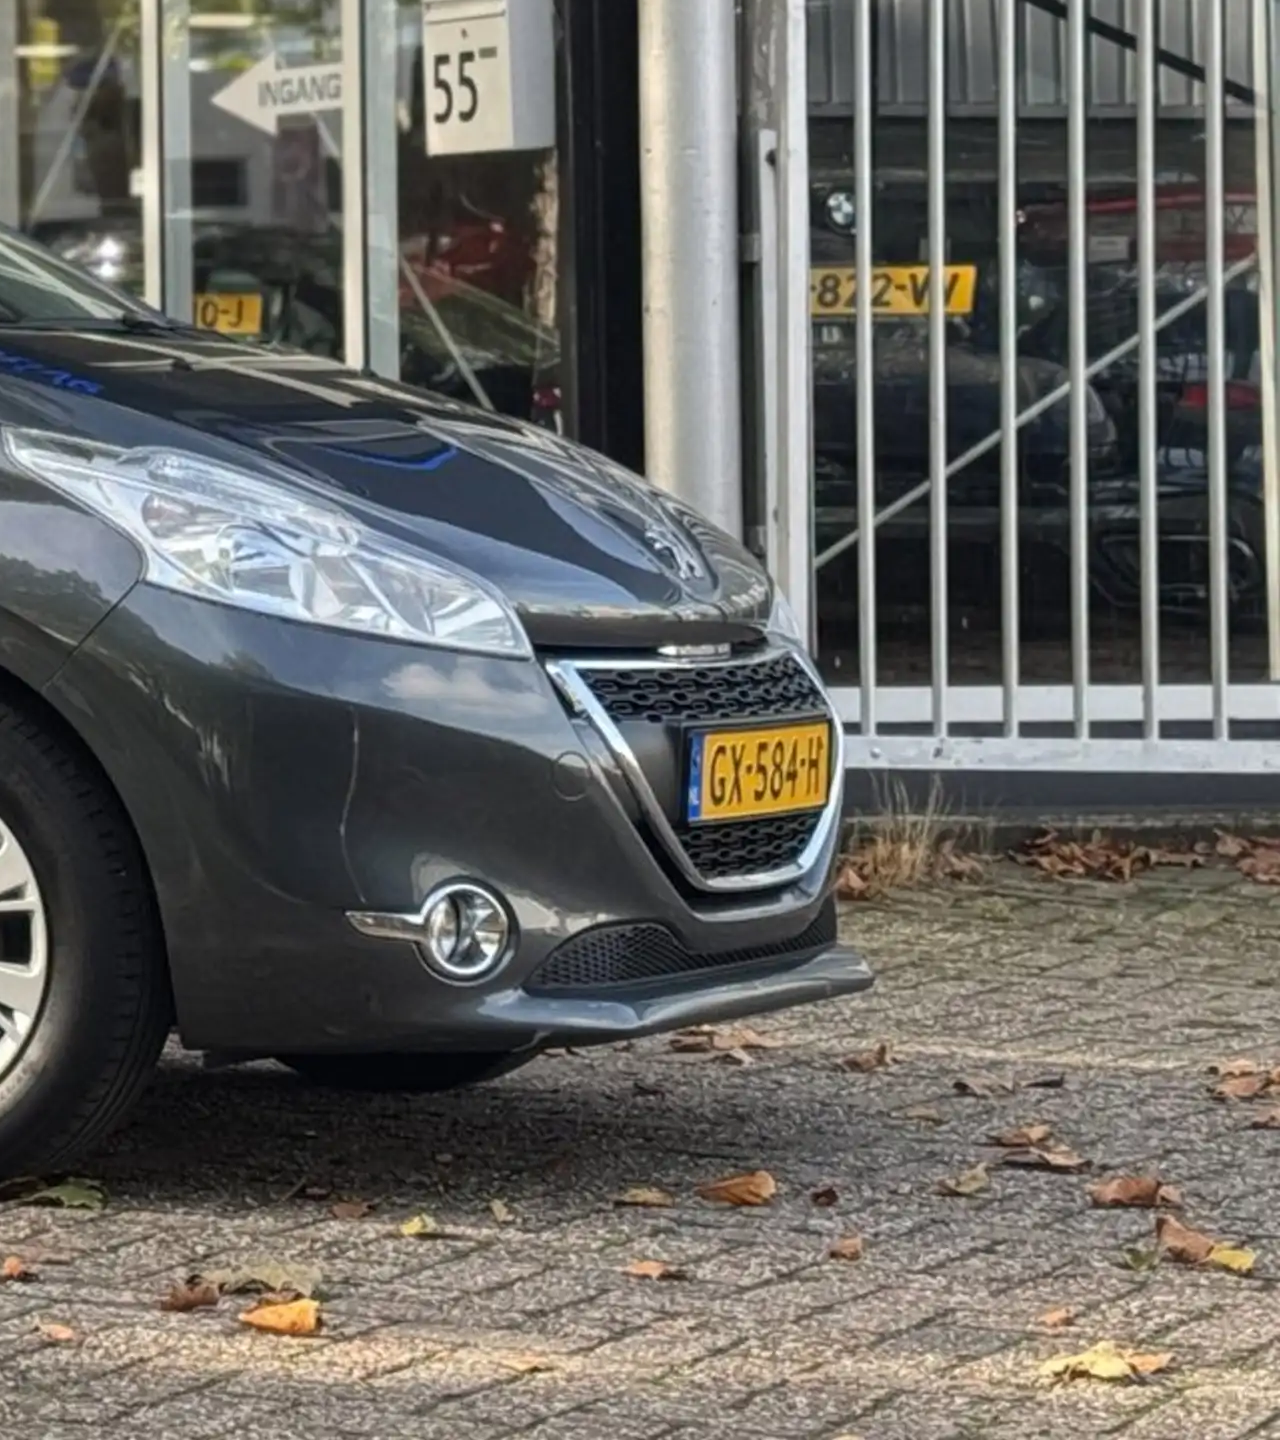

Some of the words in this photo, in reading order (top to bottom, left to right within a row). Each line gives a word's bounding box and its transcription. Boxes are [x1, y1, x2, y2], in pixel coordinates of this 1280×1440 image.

[257, 73, 342, 107] INGANG
[433, 50, 478, 124] 55
[709, 736, 824, 807] GX-584-H
